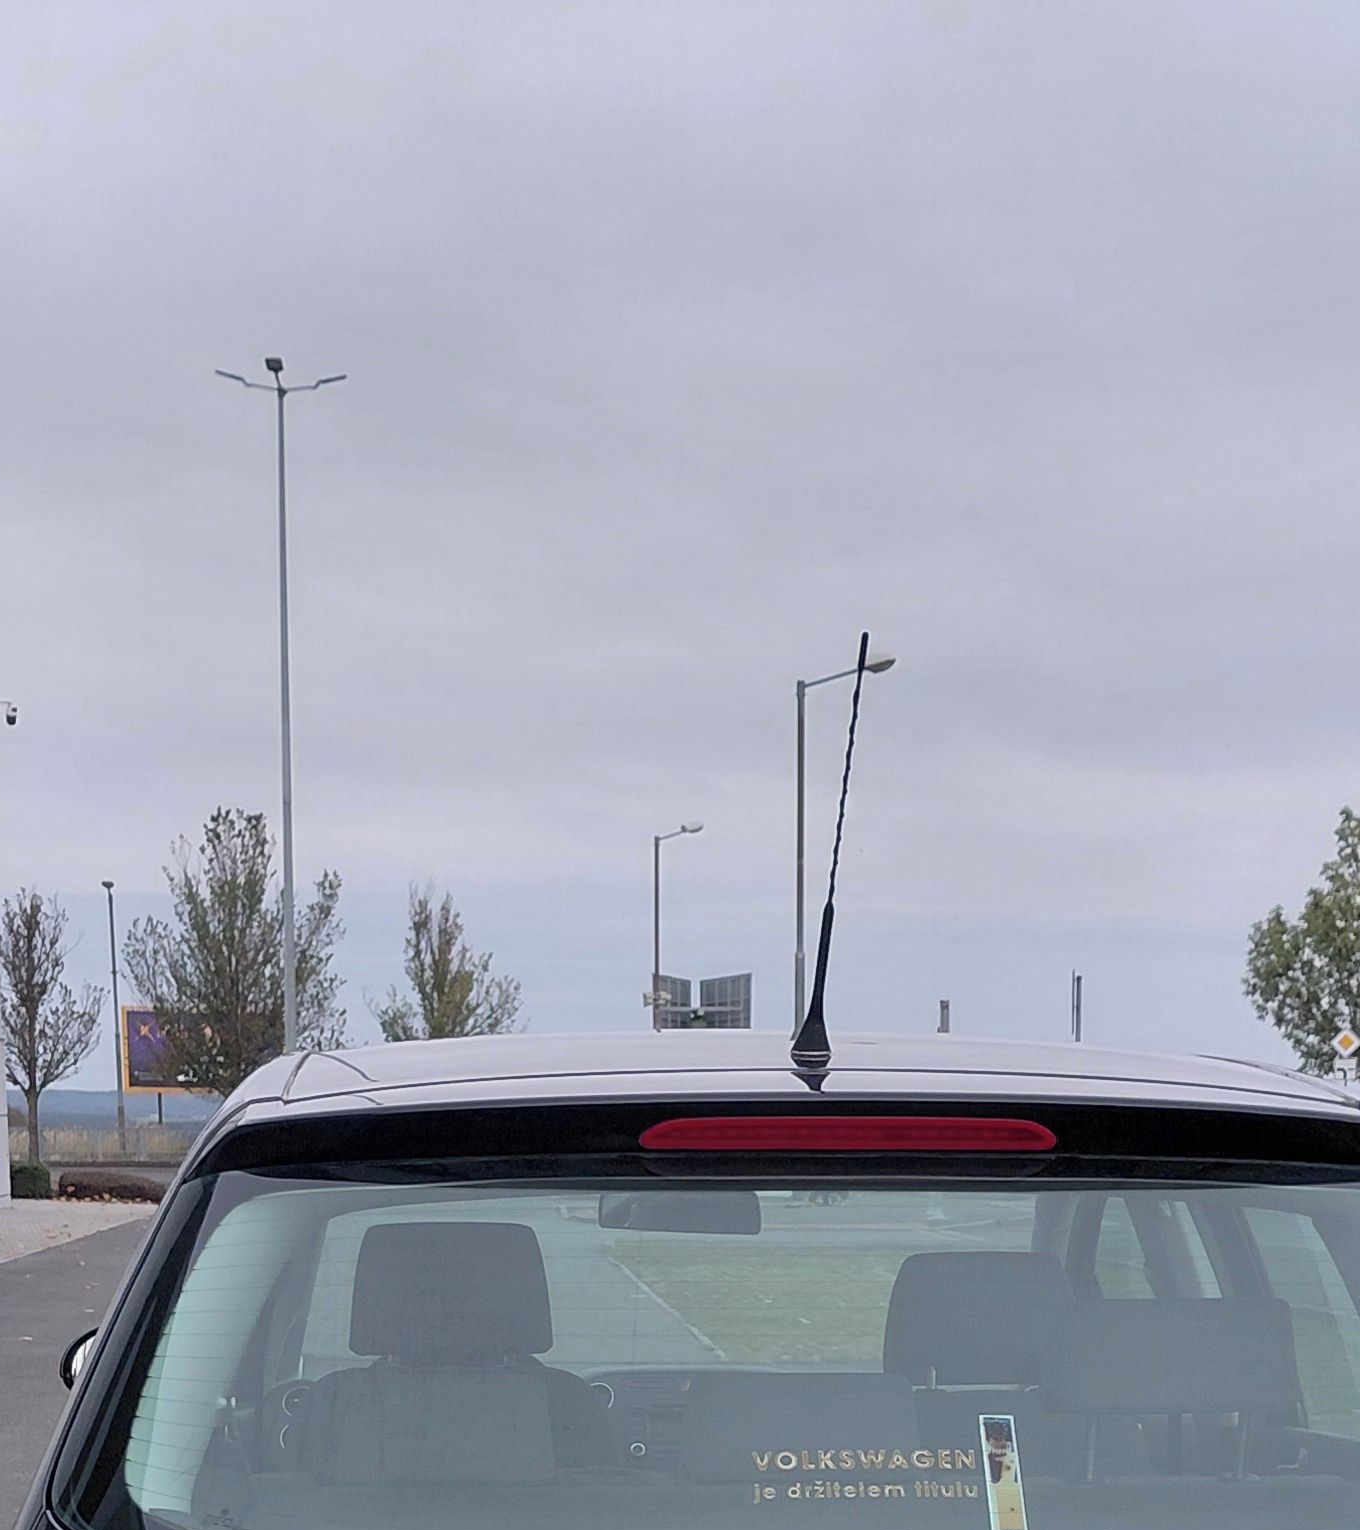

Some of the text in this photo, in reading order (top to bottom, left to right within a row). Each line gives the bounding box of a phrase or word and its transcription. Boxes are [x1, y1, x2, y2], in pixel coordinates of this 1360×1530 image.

[752, 1449, 977, 1472] VOLKSWAGEN
[753, 1480, 979, 1505] je držitelem titulu
